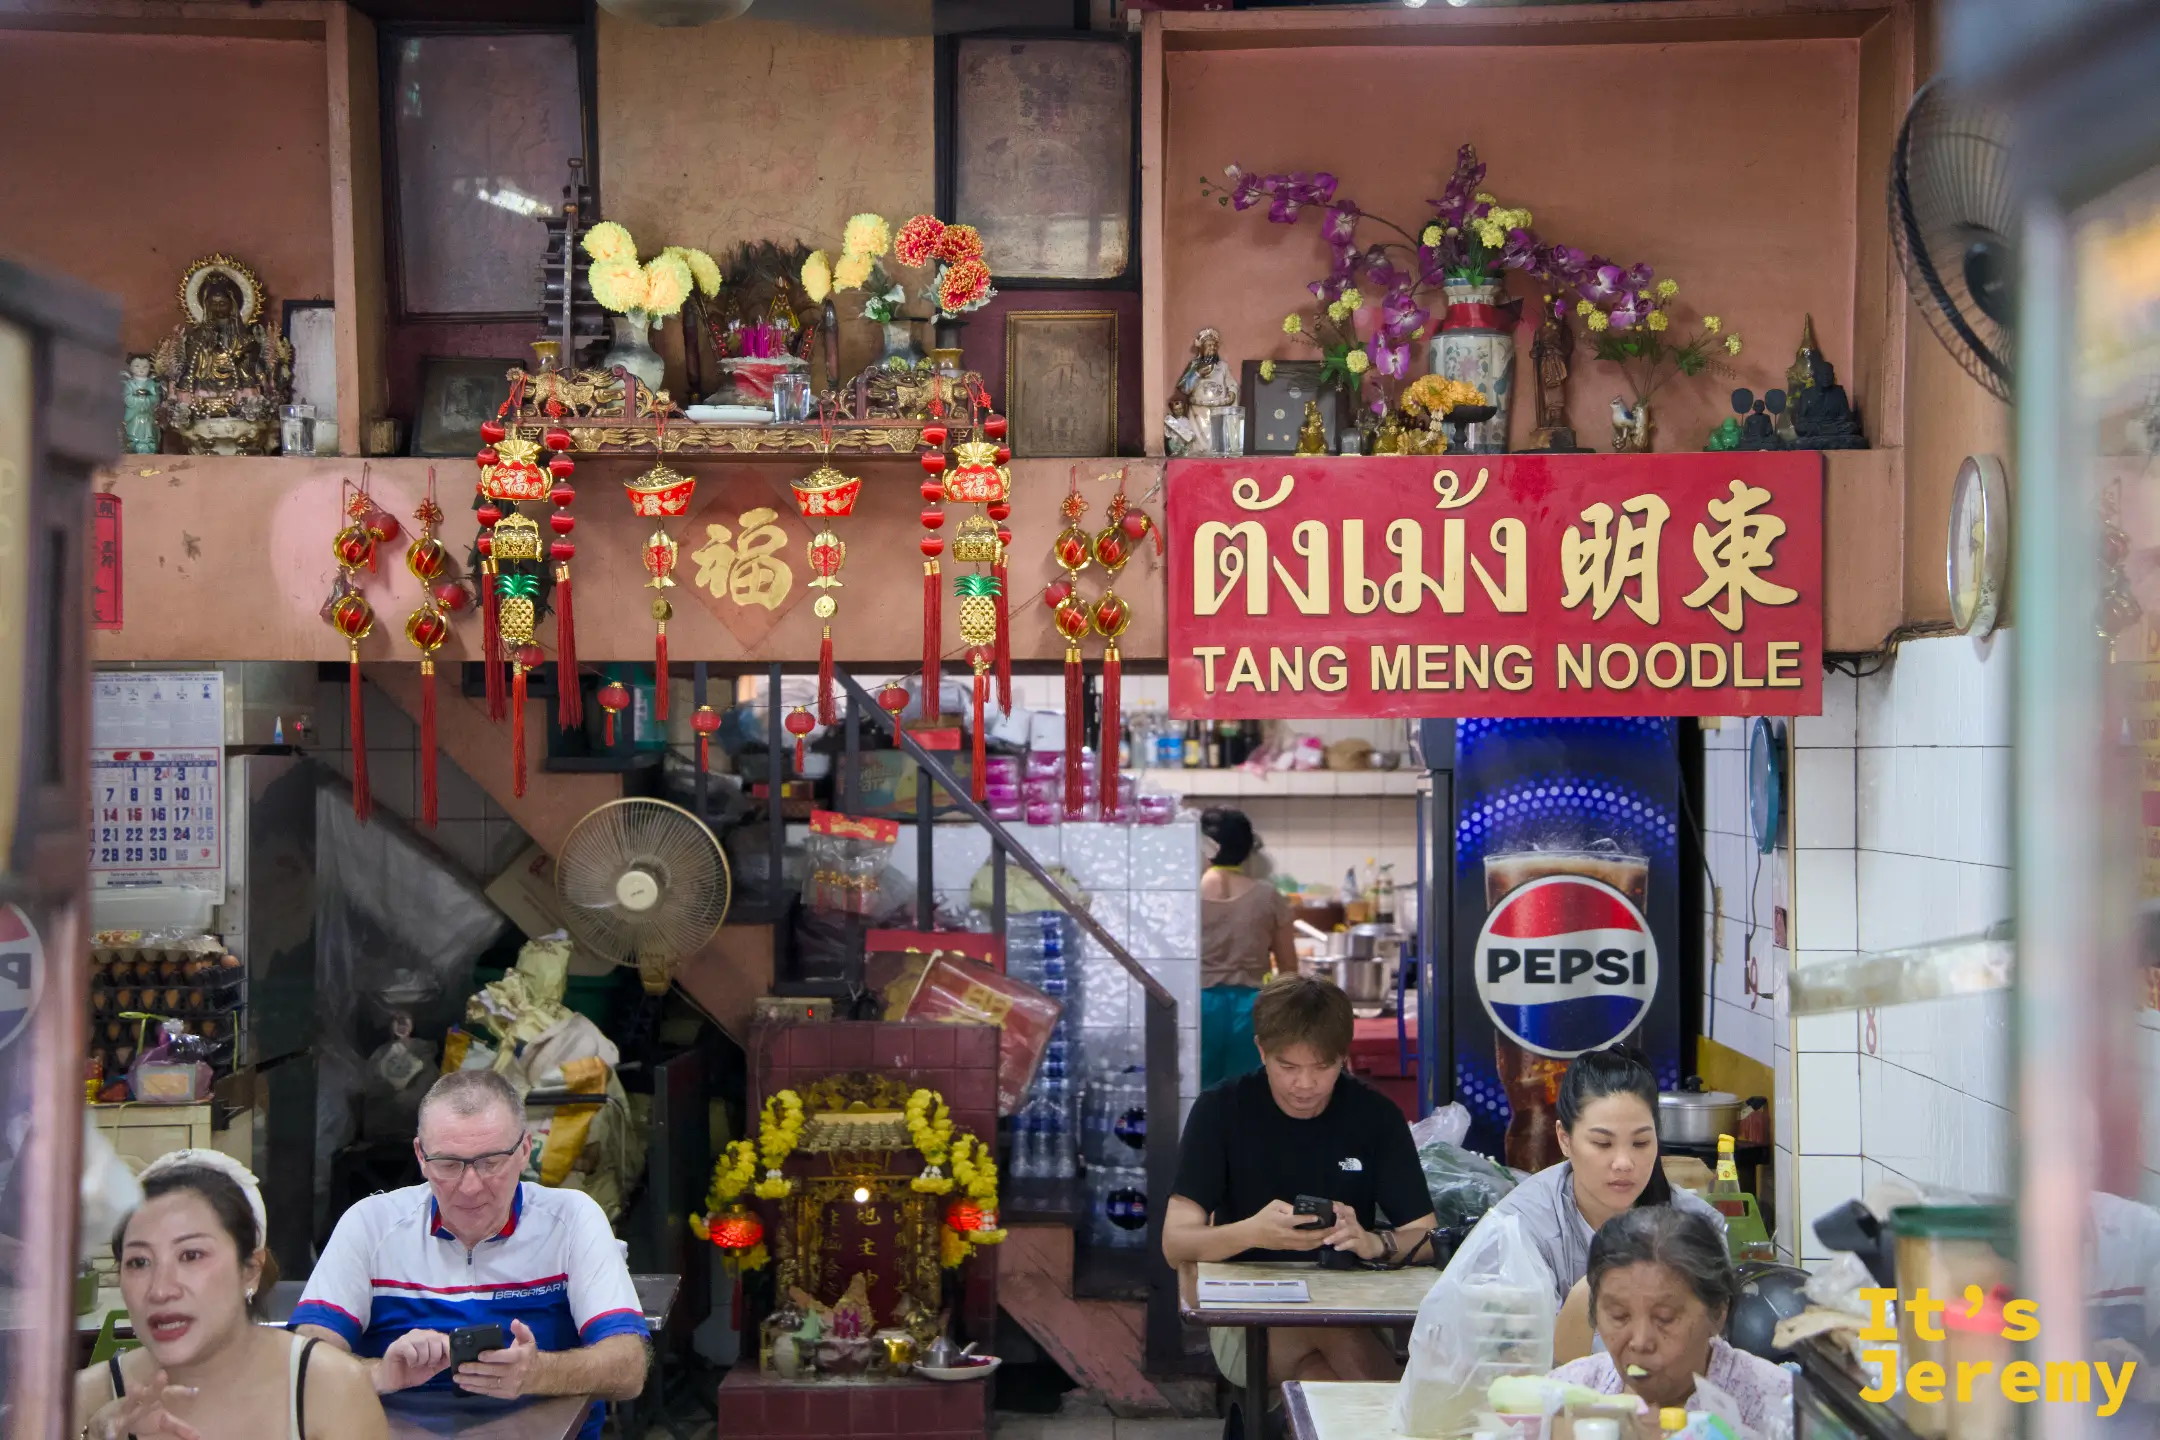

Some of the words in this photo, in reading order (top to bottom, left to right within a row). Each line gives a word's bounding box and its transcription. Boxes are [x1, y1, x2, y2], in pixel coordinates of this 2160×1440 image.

[691, 507, 793, 611] 福
[1192, 646, 1348, 692] TANG
[1370, 644, 1533, 691] MENG
[1557, 641, 1801, 689] NOODLE
[154, 767, 163, 781] 2
[106, 787, 115, 802] 7
[154, 787, 163, 801] 9
[174, 787, 190, 801] 10
[103, 807, 119, 822] 14
[126, 807, 143, 822] 15
[150, 807, 167, 822] 16
[174, 807, 190, 821] 17
[102, 828, 119, 842] 21
[125, 828, 143, 842] 22
[149, 827, 167, 842] 23
[173, 827, 190, 841] 24
[102, 848, 119, 862] 28
[125, 848, 143, 862] 29
[149, 847, 167, 861] 30
[1487, 949, 1646, 985] PEPSI
